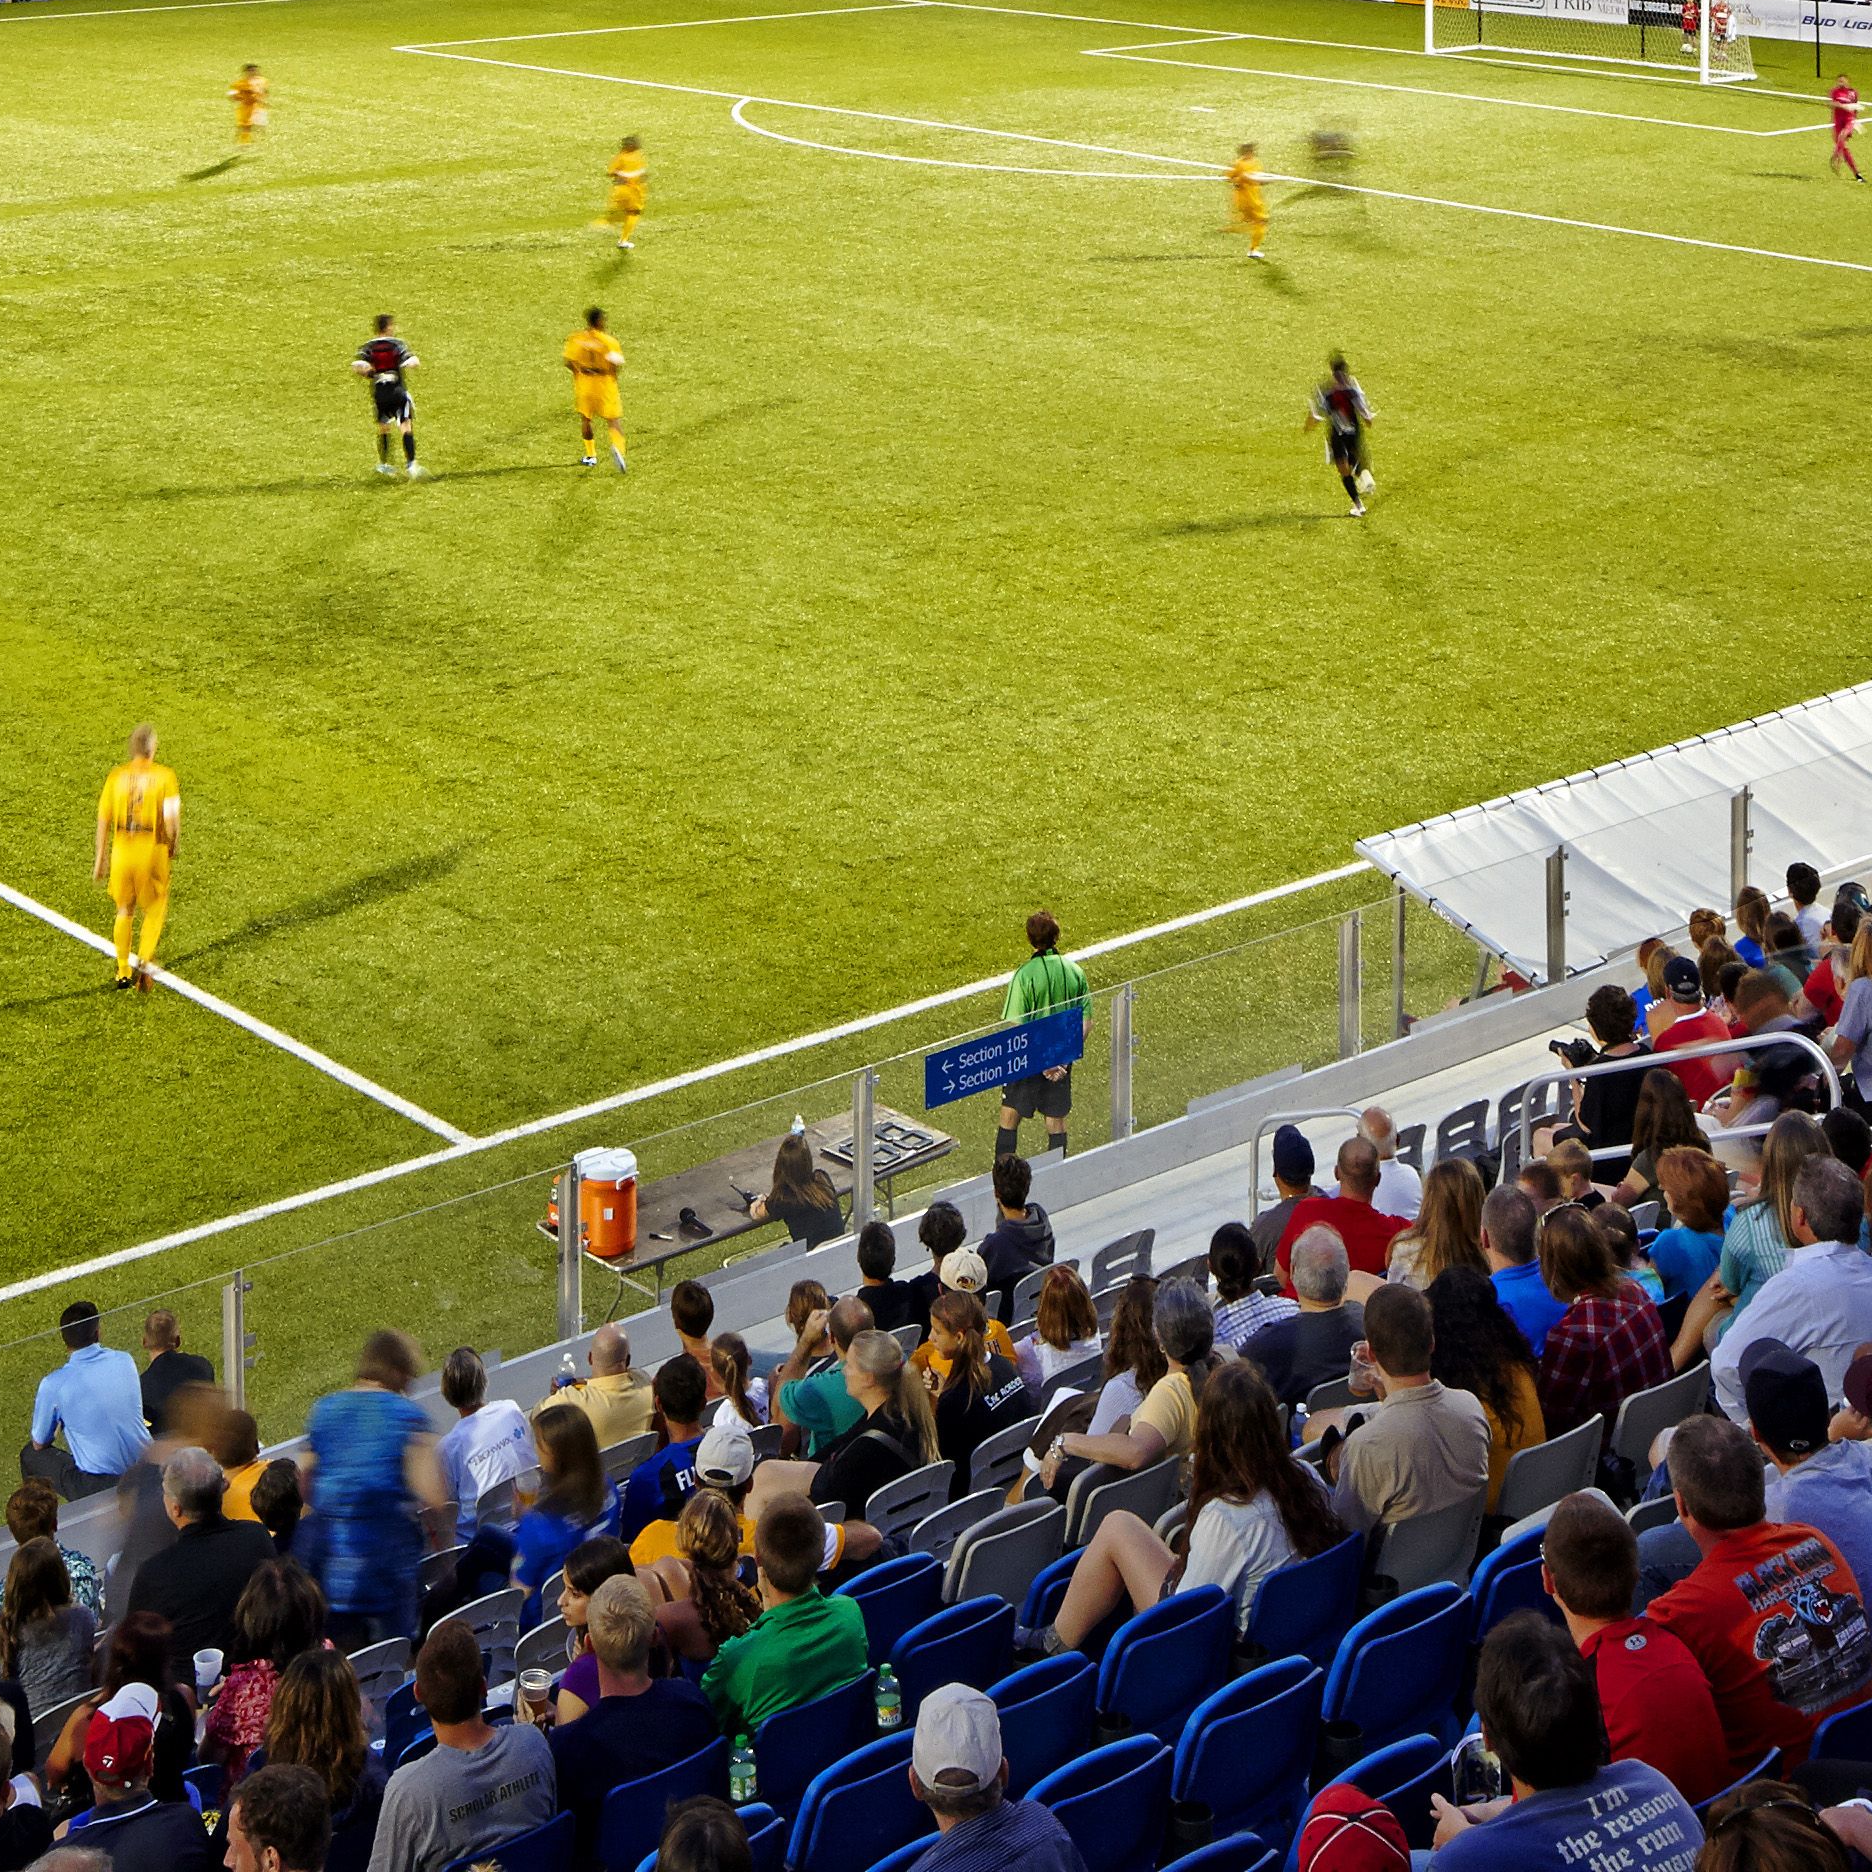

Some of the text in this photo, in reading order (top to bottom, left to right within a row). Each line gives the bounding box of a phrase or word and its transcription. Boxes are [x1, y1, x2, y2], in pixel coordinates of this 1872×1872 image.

[1597, 2, 1626, 16] MEDIA
[1802, 15, 1836, 27] BUD
[959, 1033, 1028, 1069] Section 105
[959, 1055, 1028, 1091] Section 104
[1734, 1553, 1790, 1605] BLACK
[449, 1770, 542, 1824] SCHOLAR ATHLETE
[1587, 1786, 1630, 1820] I'm
[1556, 1791, 1678, 1864] the reason
[1589, 1822, 1684, 1872] the rum
